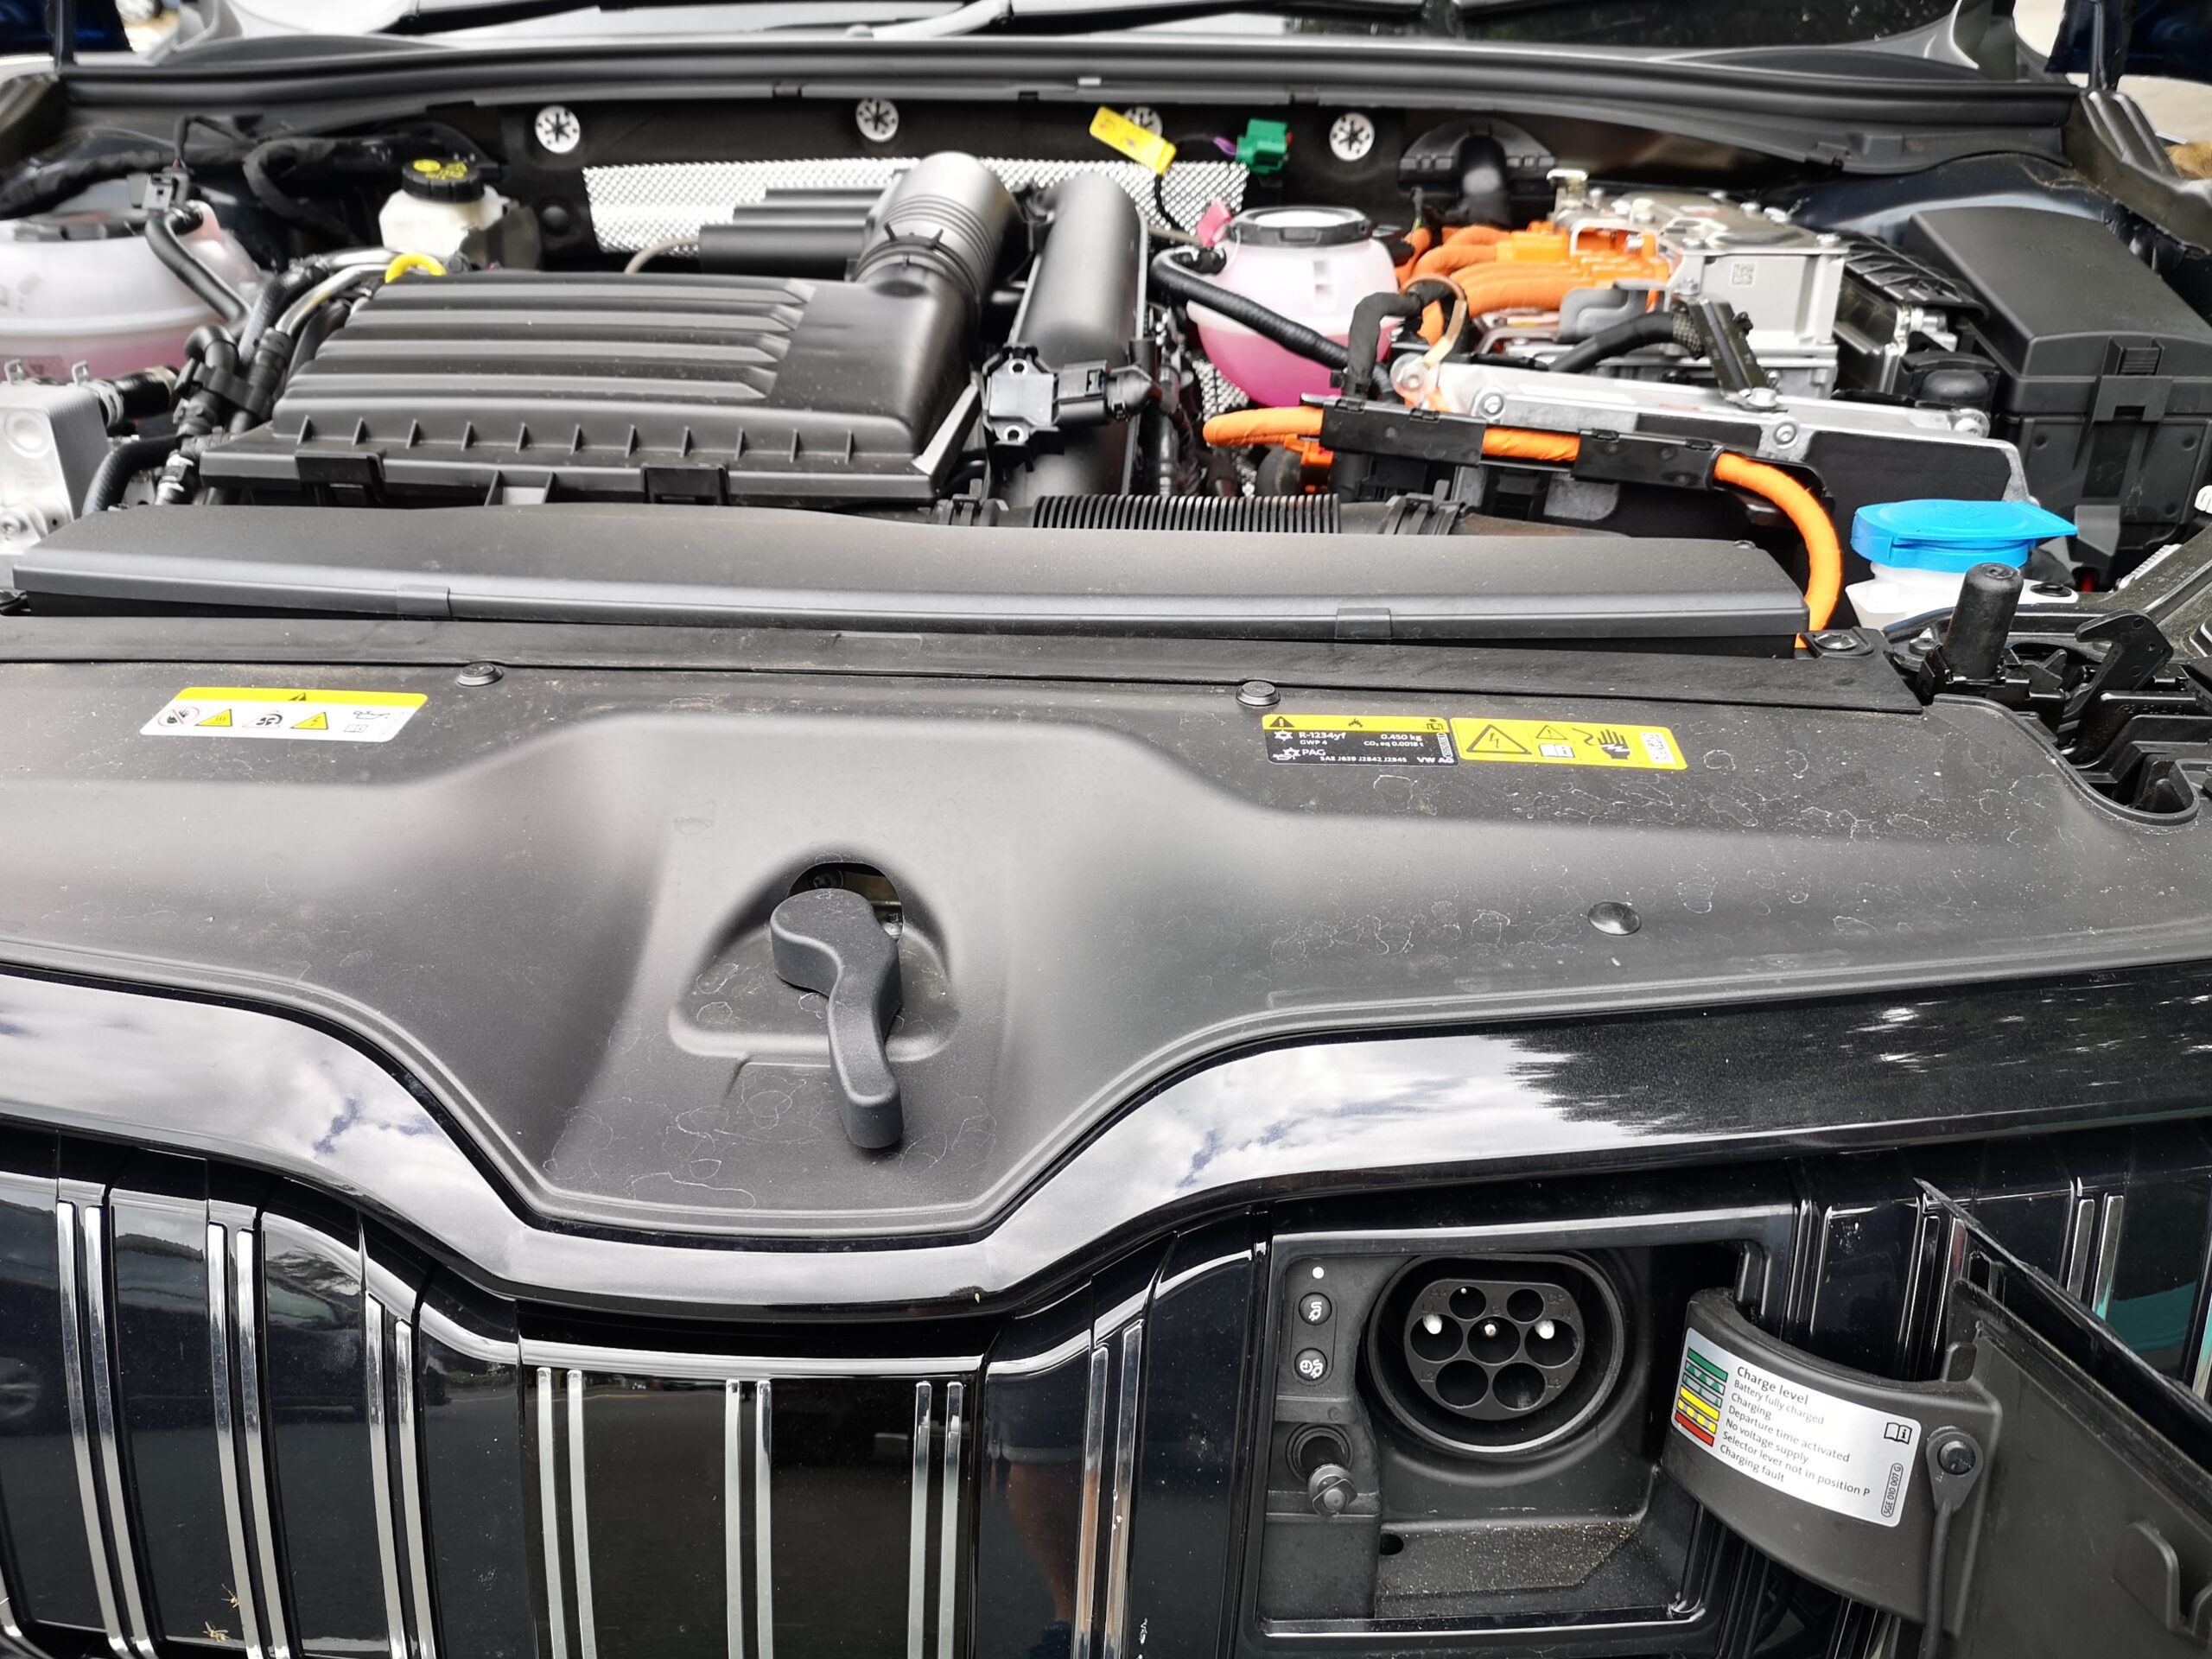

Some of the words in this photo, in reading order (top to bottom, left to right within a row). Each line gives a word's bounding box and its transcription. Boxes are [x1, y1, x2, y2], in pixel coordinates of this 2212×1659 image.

[1733, 1379, 1764, 1402] Battery
[1764, 1395, 1785, 1410] fully
[1786, 1405, 1825, 1424] charged
[1737, 1366, 1777, 1392] Charge
[1778, 1384, 1808, 1405] level
[1732, 1393, 1771, 1421] Charging
[1726, 1418, 1738, 1431] No
[1740, 1427, 1773, 1448] voltage
[1776, 1445, 1809, 1464] supply
[1728, 1405, 1774, 1434] Departure
[1777, 1428, 1799, 1445] time
[1801, 1441, 1851, 1462] activated
[1719, 1445, 1759, 1473] Charging
[1761, 1465, 1784, 1483] fault
[1723, 1431, 1758, 1454] Selector
[1759, 1450, 1783, 1466] lever
[1785, 1462, 1802, 1475] not
[1805, 1470, 1815, 1479] in
[1817, 1474, 1861, 1495] position
[1863, 1488, 1870, 1497] P
[1891, 1473, 1899, 1486] 007
[1887, 1488, 1896, 1500] 010
